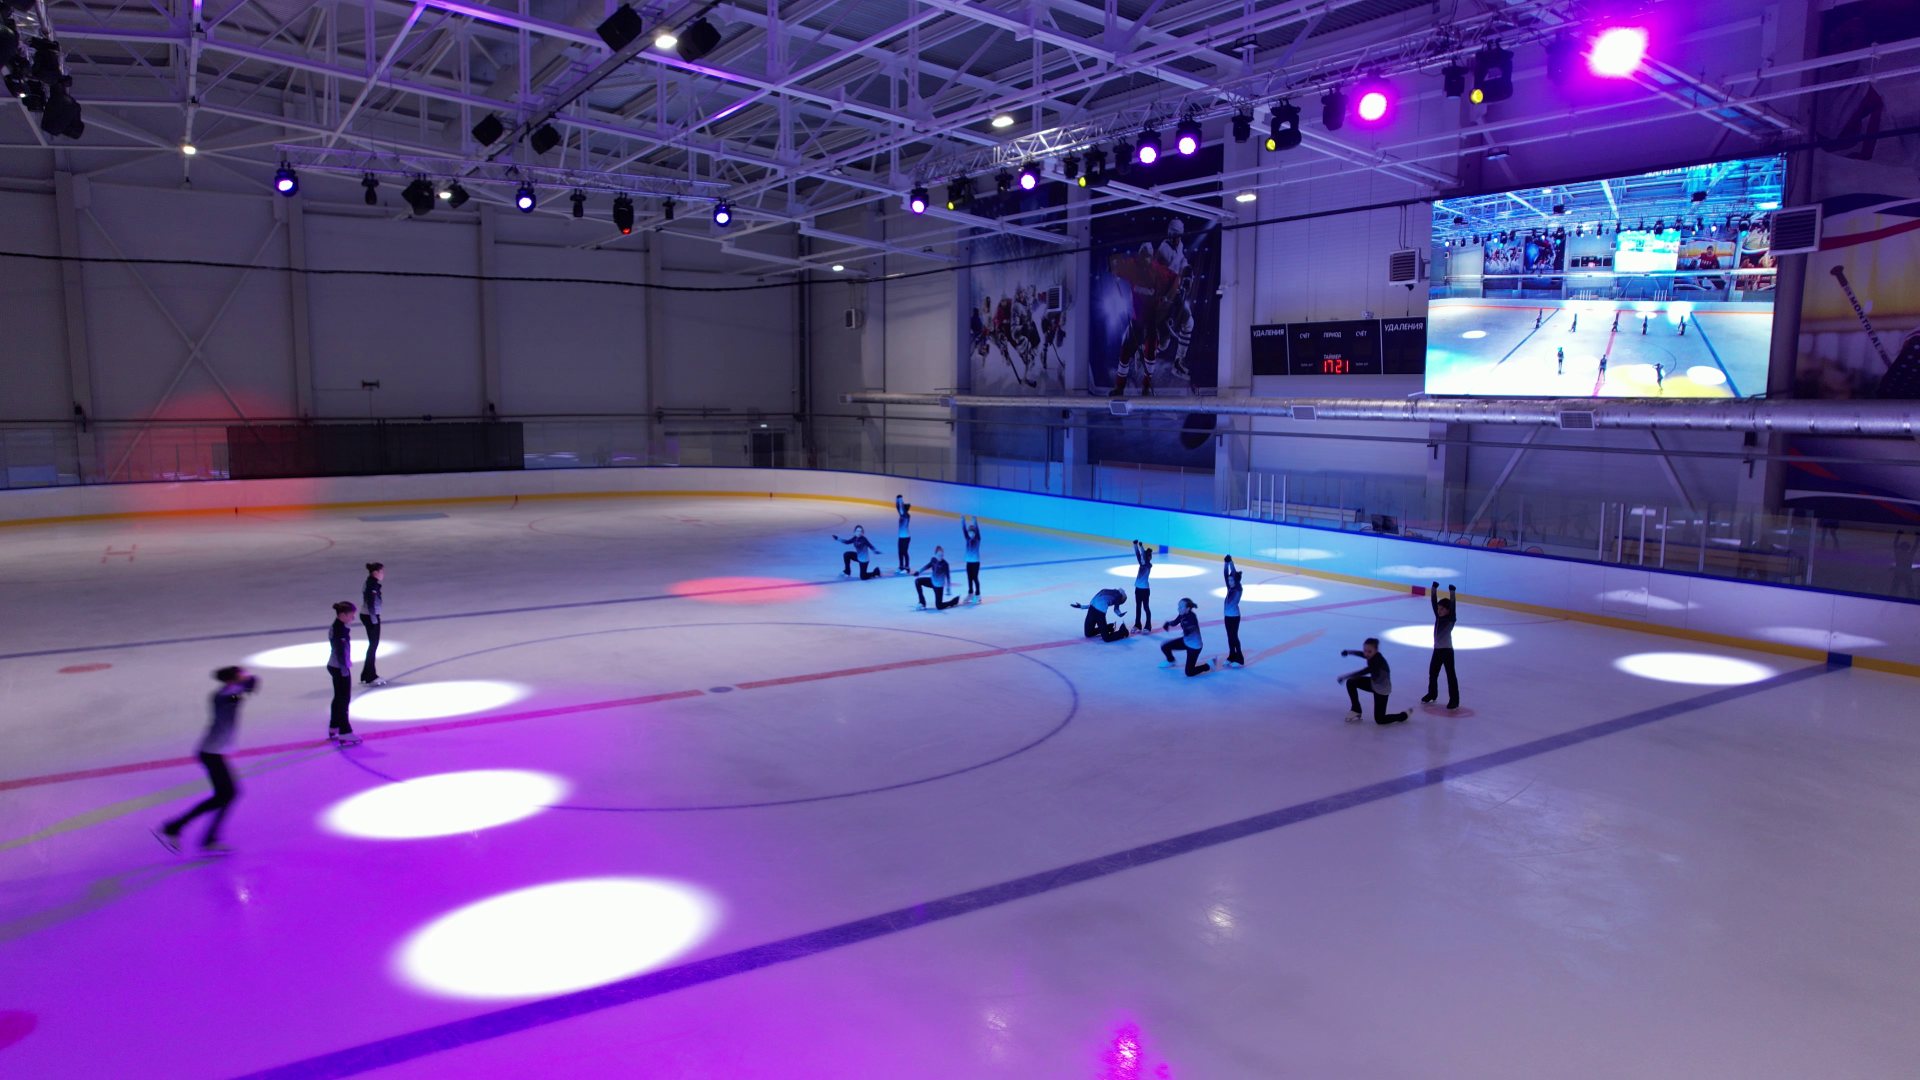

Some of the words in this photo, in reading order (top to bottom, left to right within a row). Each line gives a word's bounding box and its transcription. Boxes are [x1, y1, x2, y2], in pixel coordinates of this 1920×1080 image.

[1849, 296, 1881, 349] MONTREAL
[1384, 323, 1424, 332] УДАЛЕНИЯ
[1253, 329, 1285, 337] УДАЛЕНИЯ
